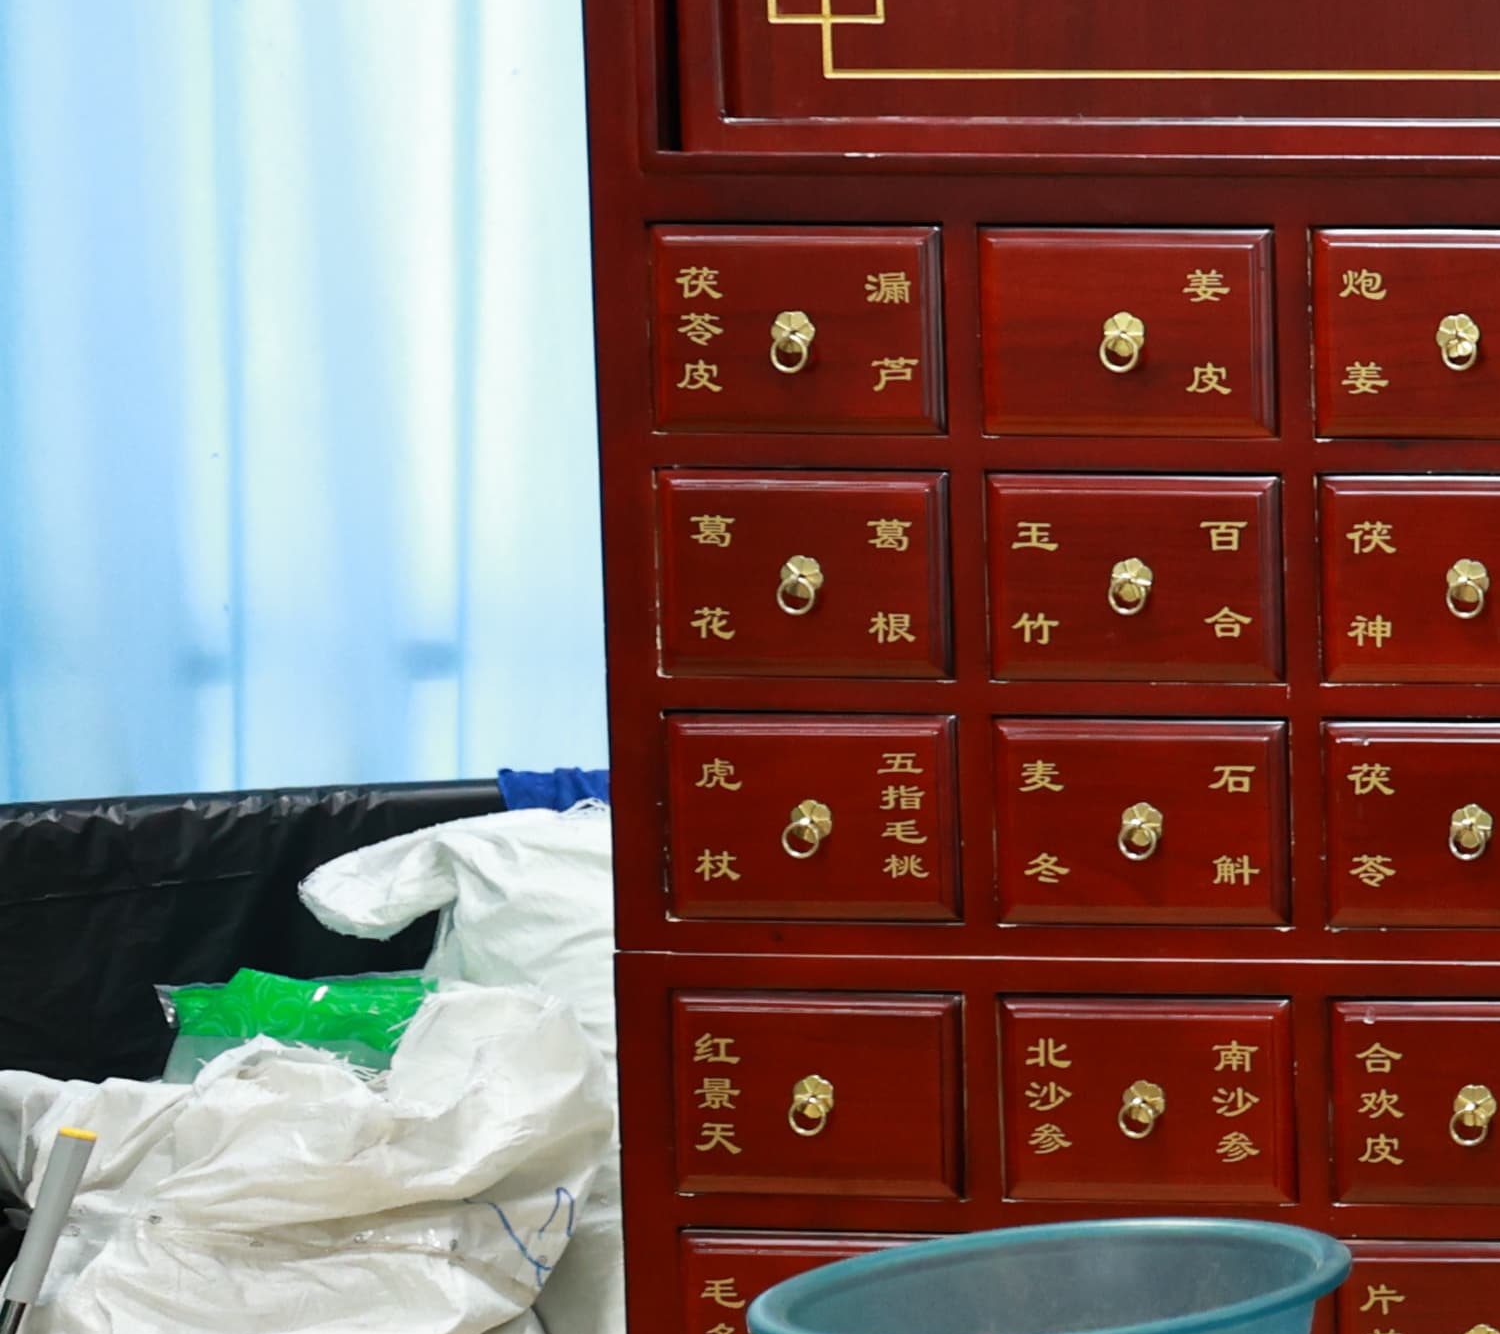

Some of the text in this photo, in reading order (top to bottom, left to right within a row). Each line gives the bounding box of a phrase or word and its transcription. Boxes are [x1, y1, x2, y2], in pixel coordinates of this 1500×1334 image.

[674, 265, 724, 394] 茯苓皮
[865, 517, 918, 644] 葛根
[1198, 520, 1254, 639] 百合
[877, 751, 930, 880] 五指毛桃
[693, 1032, 743, 1156] 红景天
[1023, 1036, 1074, 1156] 北沙参
[1210, 1039, 1261, 1164] 南沙参
[1355, 1041, 1406, 1167] 合欢皮
